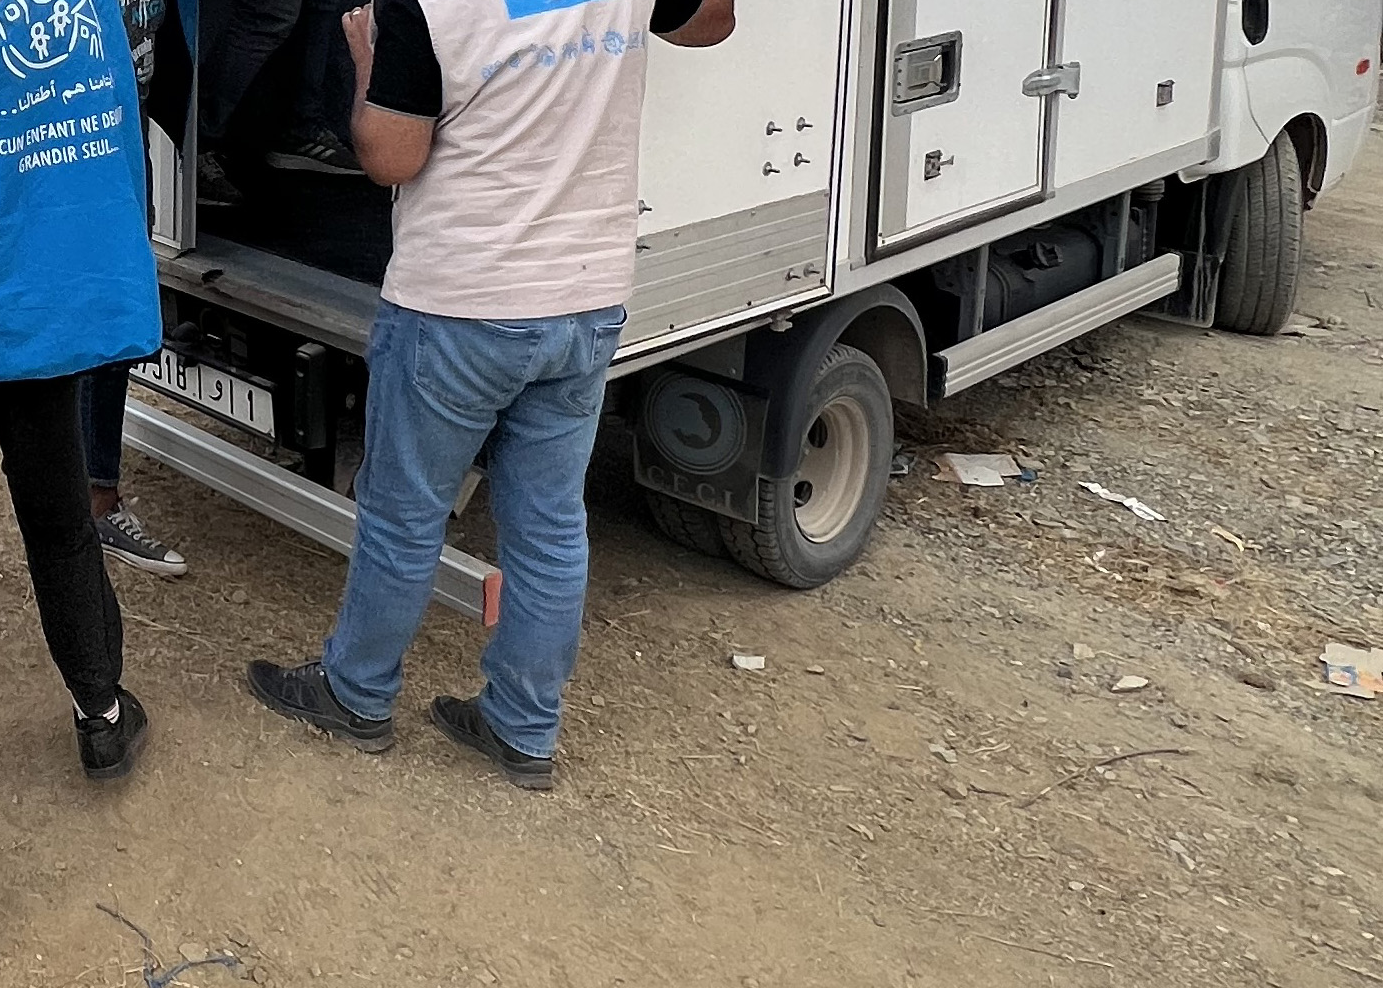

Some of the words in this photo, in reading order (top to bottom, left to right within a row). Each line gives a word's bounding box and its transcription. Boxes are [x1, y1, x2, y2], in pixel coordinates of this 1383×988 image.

[62, 82, 86, 105] هم
[26, 119, 76, 147] ENFANT
[80, 114, 99, 134] NE
[18, 145, 78, 174] GRANDIR
